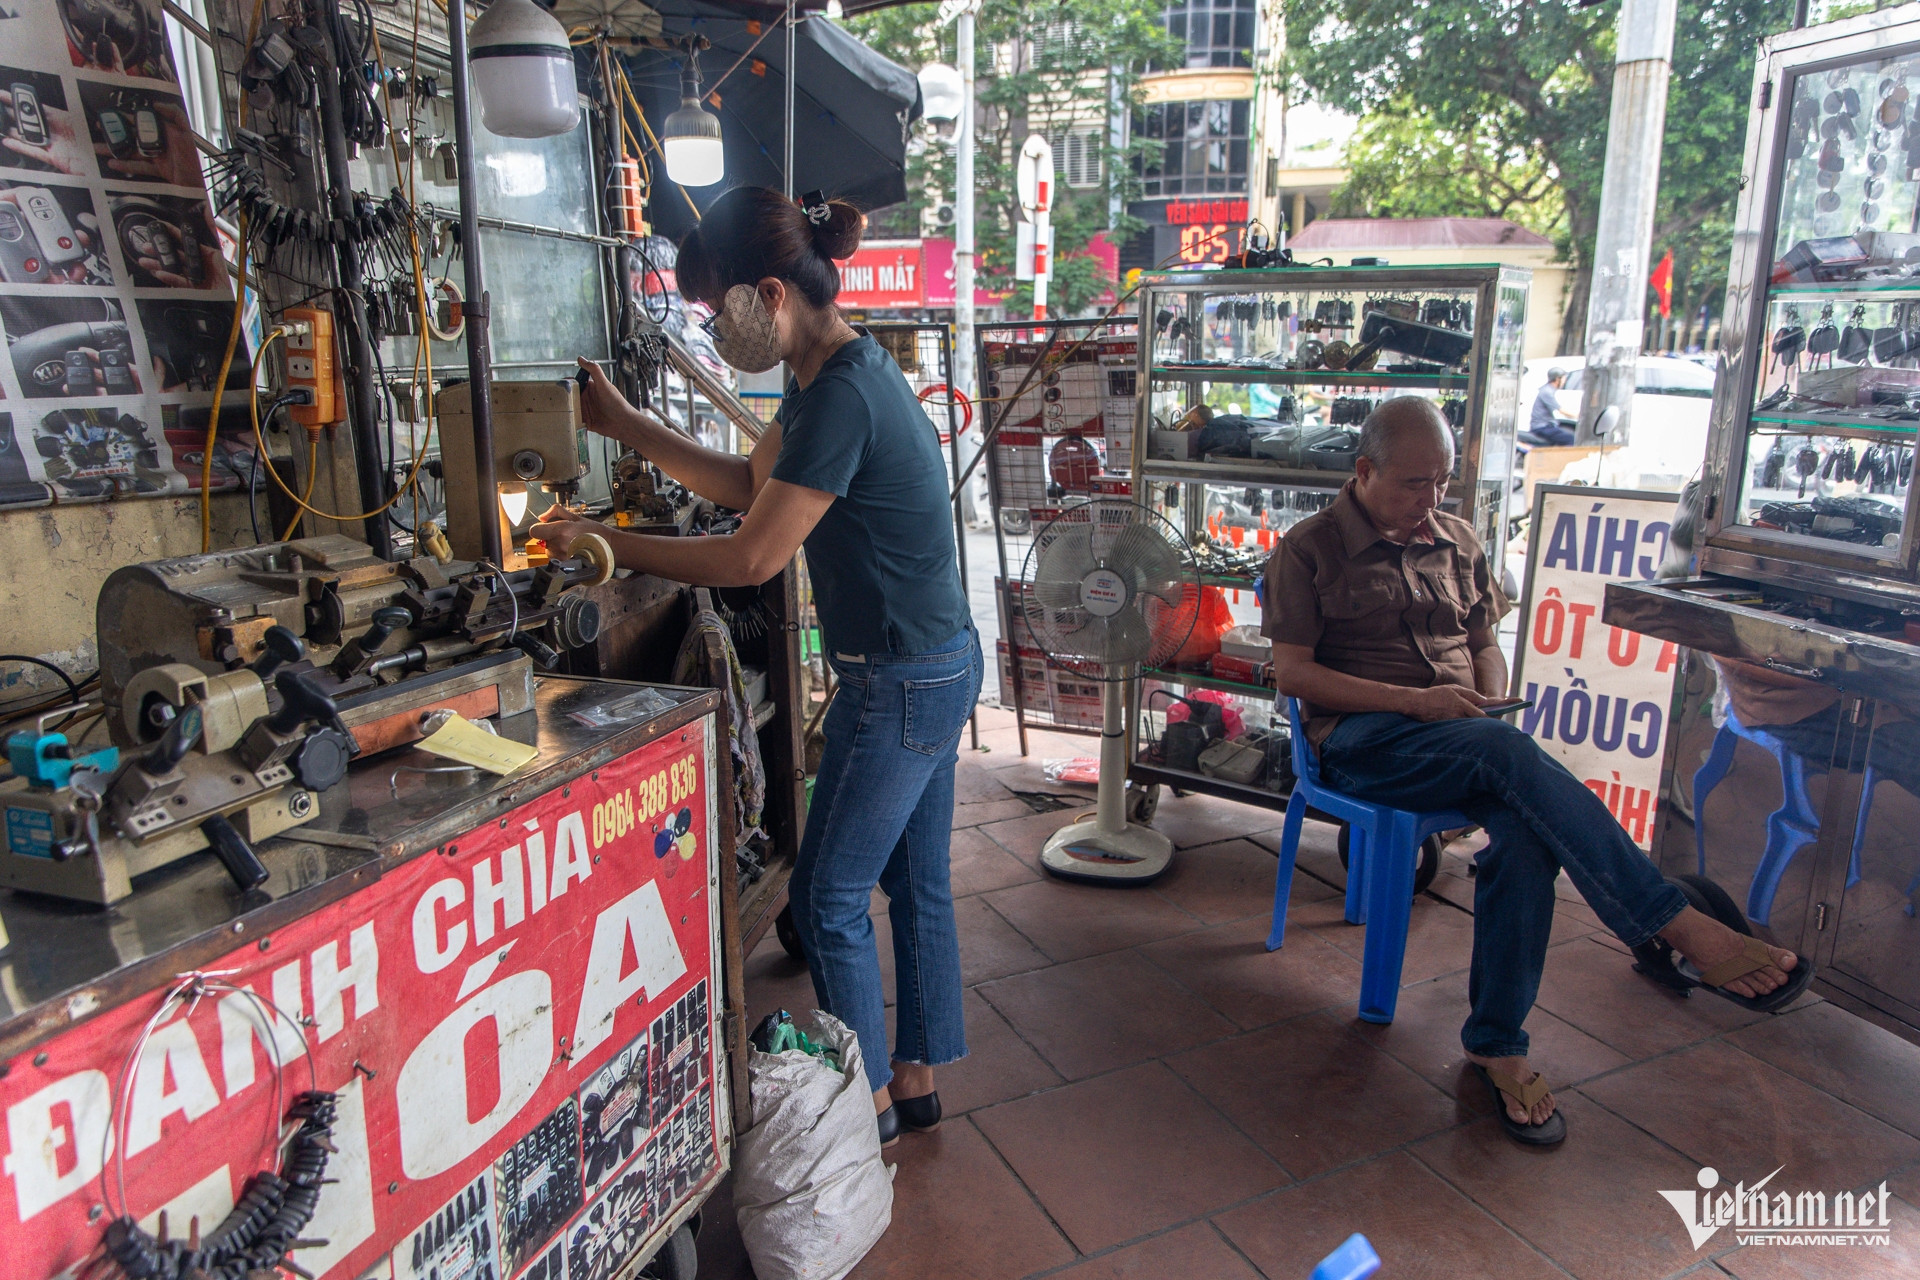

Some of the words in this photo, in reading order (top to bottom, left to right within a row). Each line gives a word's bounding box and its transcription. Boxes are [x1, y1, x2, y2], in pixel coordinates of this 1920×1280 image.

[878, 254, 916, 292] MẮT
[35, 365, 63, 381] KIA
[592, 788, 634, 849] 0964
[638, 773, 667, 824] 388
[670, 753, 697, 805] 836
[4, 920, 379, 1224] ĐÁNH
[412, 810, 592, 974] CHÌA
